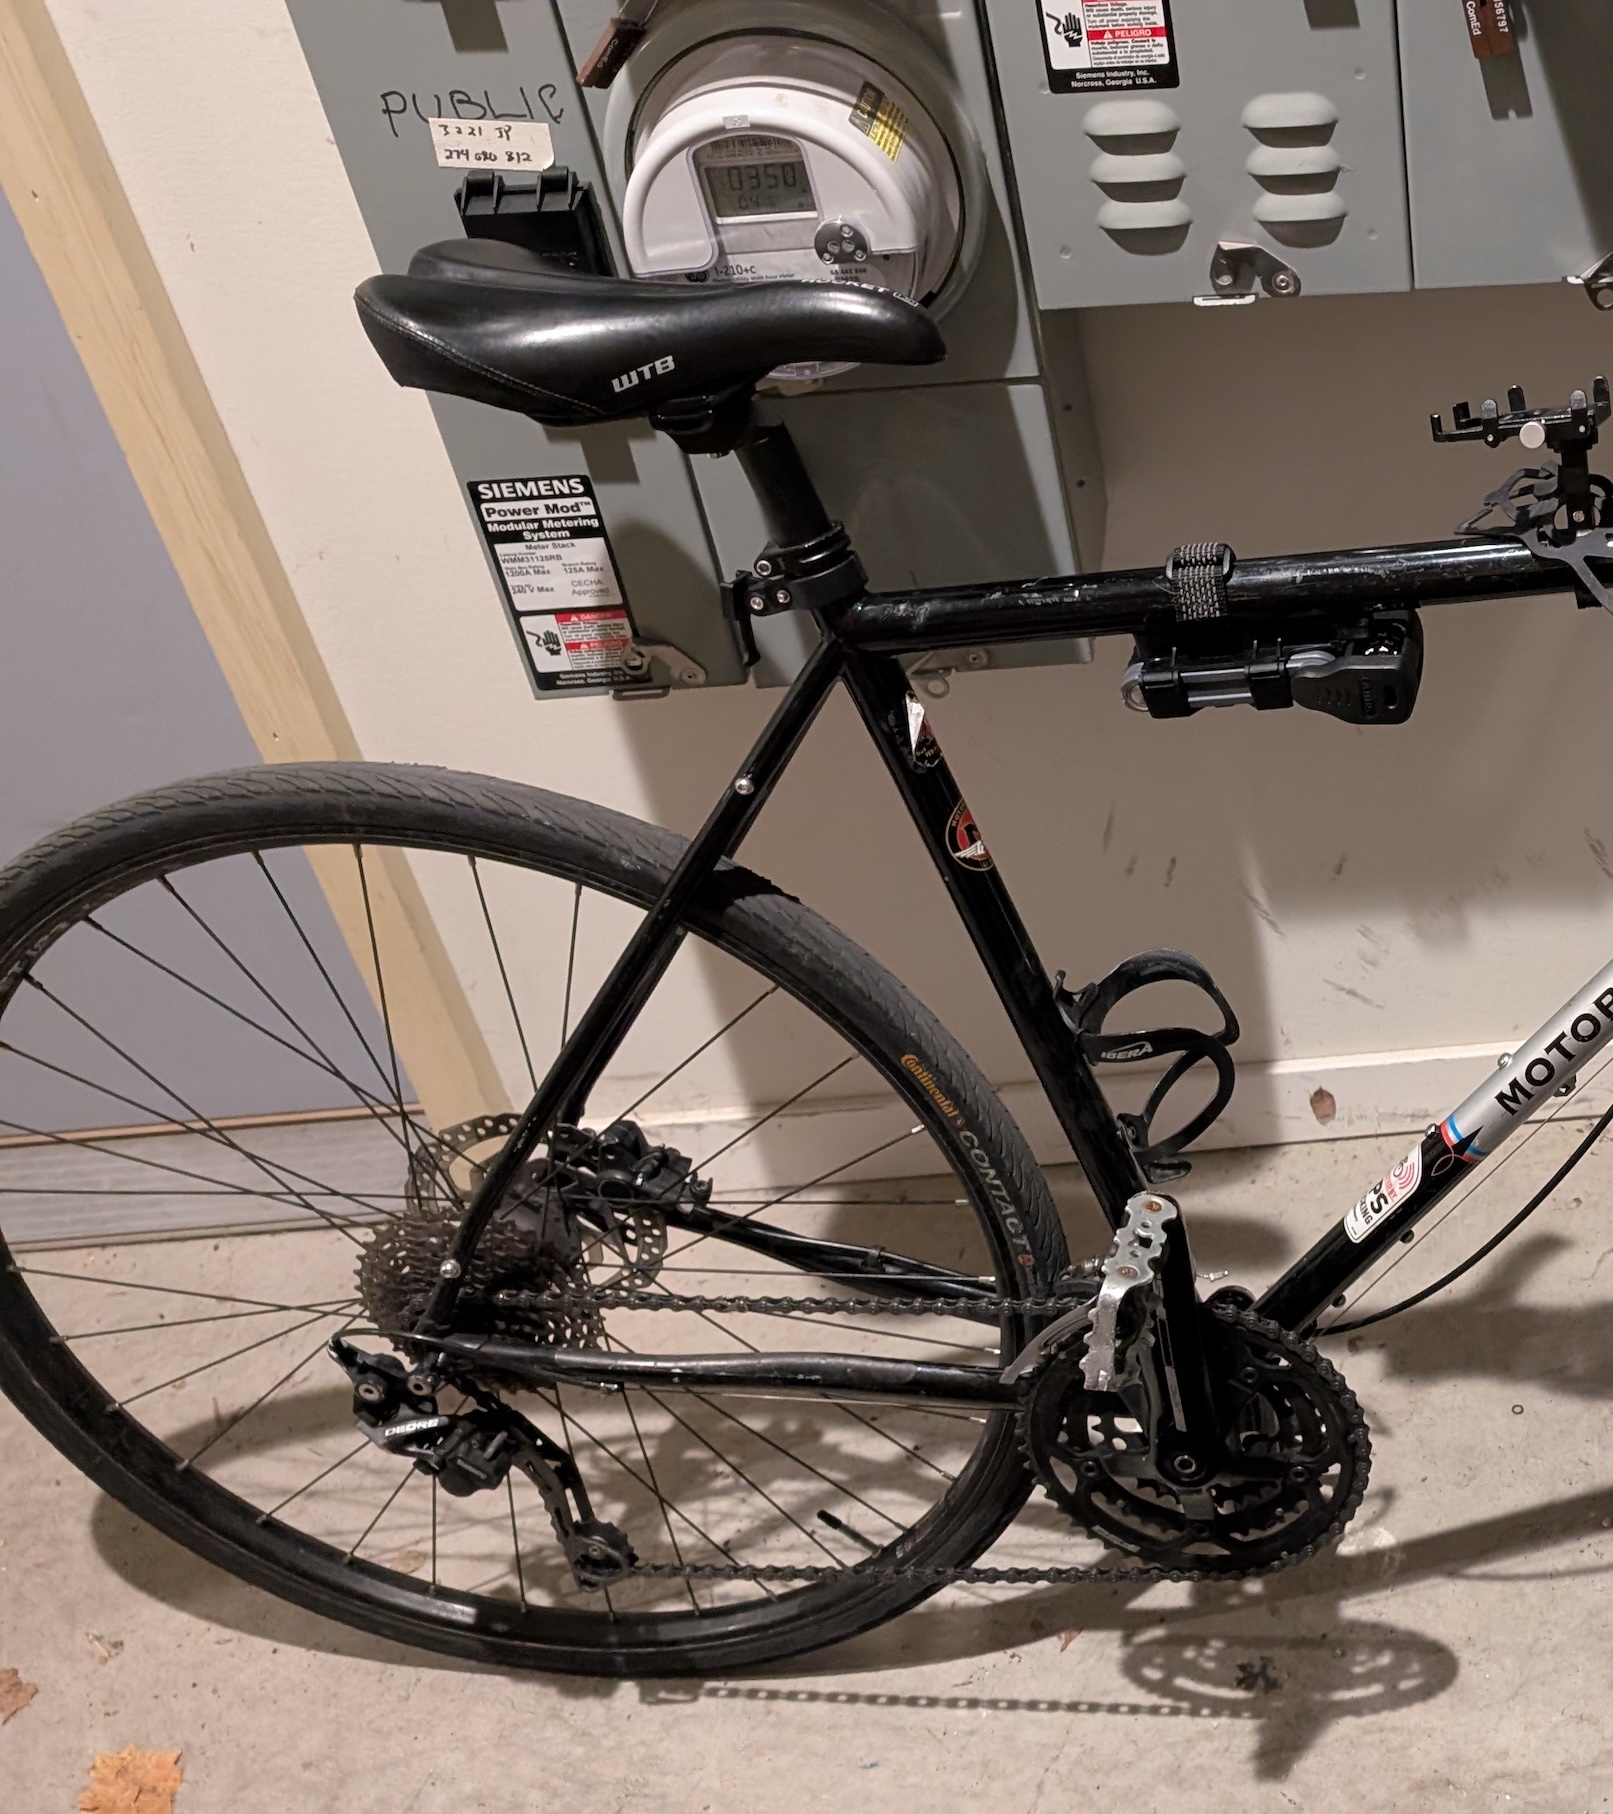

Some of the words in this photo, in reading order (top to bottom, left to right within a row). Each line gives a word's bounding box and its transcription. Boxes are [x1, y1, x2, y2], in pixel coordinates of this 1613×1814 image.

[1466, 1, 1482, 36] ComEd
[1493, 0, 1509, 33] 56797
[1115, 28, 1152, 37] PELIGRO
[1071, 80, 1104, 88] Norcross,
[1106, 78, 1132, 86] Georgia
[506, 149, 532, 164] 812
[611, 355, 675, 393] WTB
[478, 477, 584, 500] SIEMENS
[484, 504, 539, 518] Power
[487, 520, 539, 532] Modular
[543, 516, 600, 528] Metering
[522, 530, 570, 542] System
[505, 570, 532, 578] 1200A
[571, 587, 610, 597] Approved
[1101, 1041, 1153, 1059] IBERA
[901, 1053, 959, 1120] Continental
[959, 1130, 1031, 1253] CONTACT
[1369, 1179, 1388, 1214] PS
[1360, 1198, 1373, 1225] KING
[385, 1418, 439, 1436] DEORE
